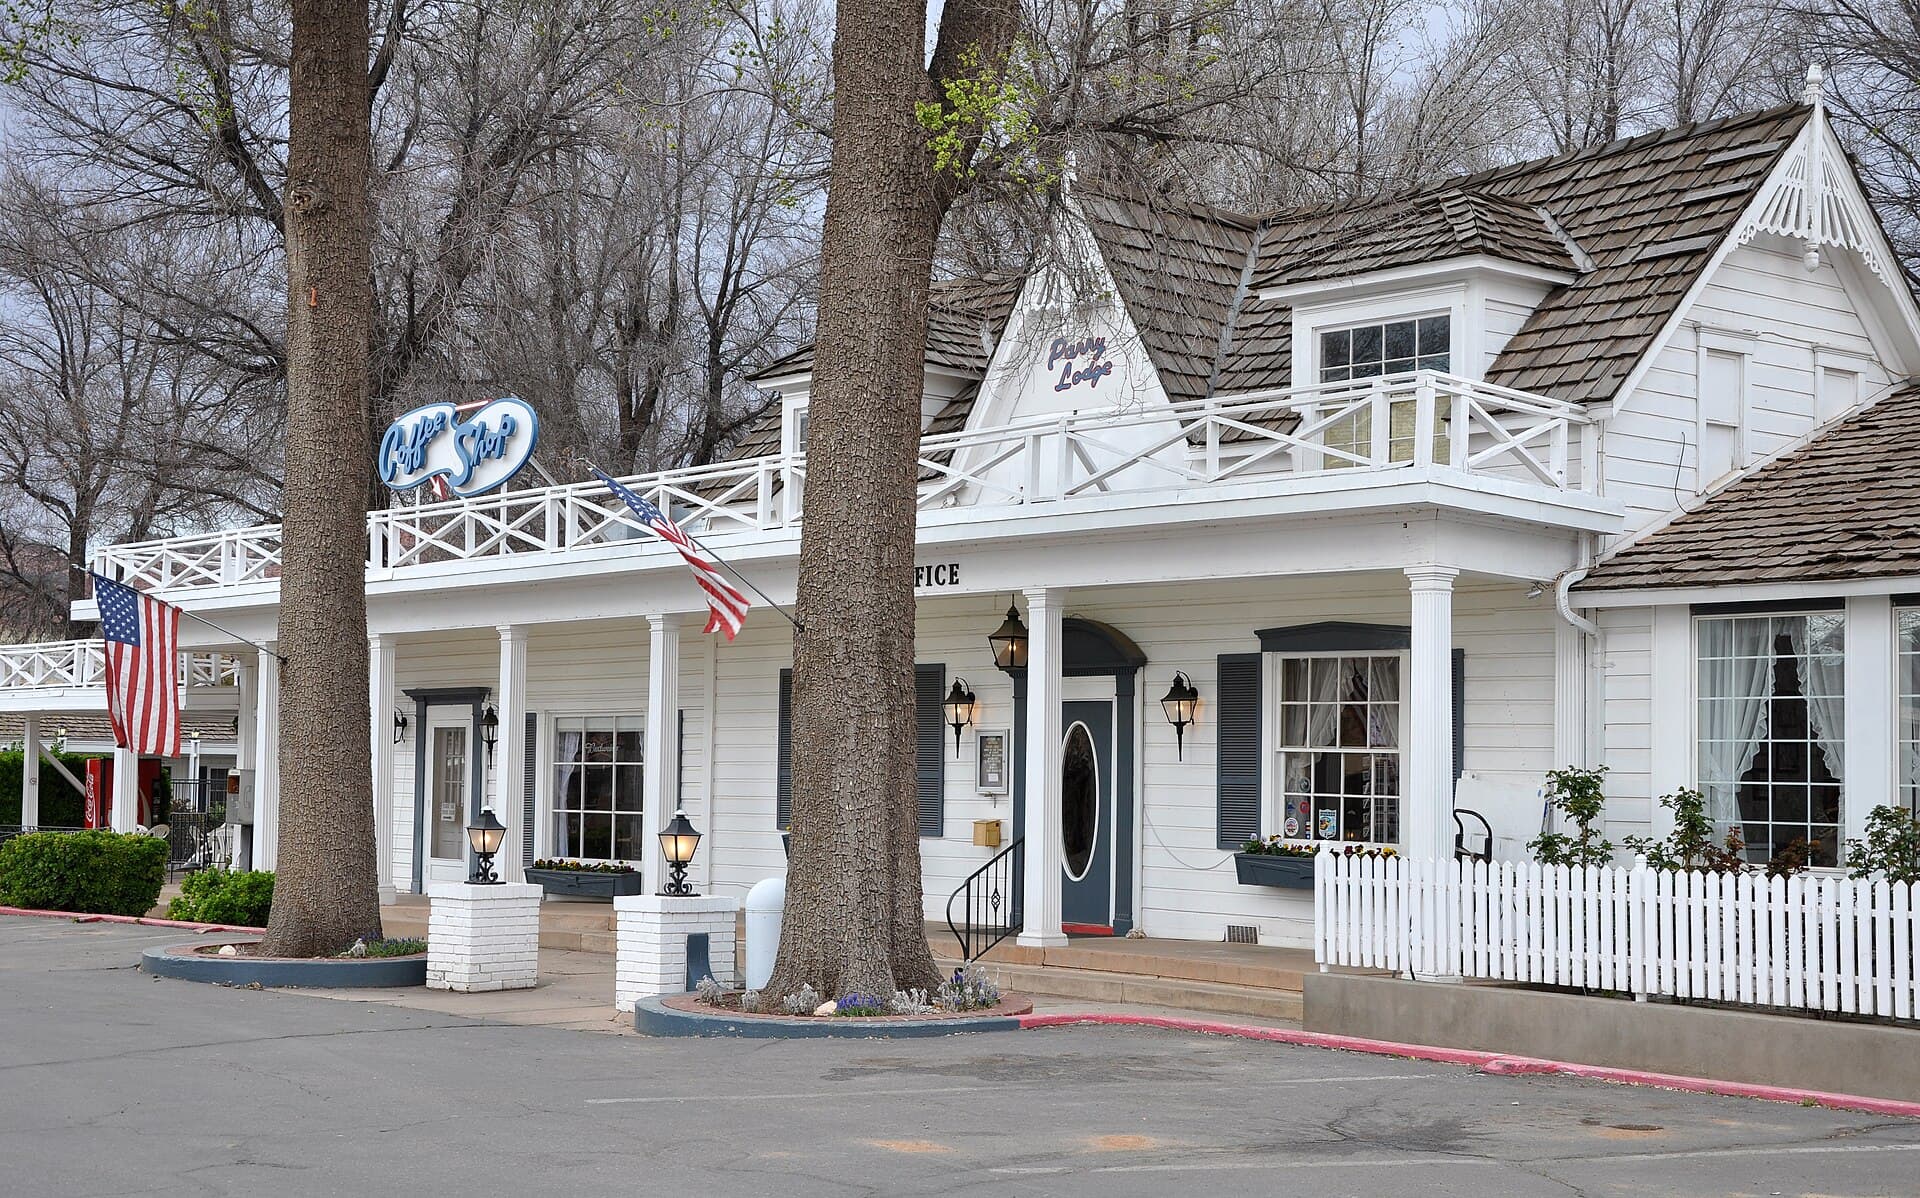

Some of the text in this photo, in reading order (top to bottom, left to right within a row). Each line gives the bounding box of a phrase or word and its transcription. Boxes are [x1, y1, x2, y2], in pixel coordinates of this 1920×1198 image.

[1054, 361, 1113, 392] Lodge
[379, 411, 518, 488] Coffee Shop
